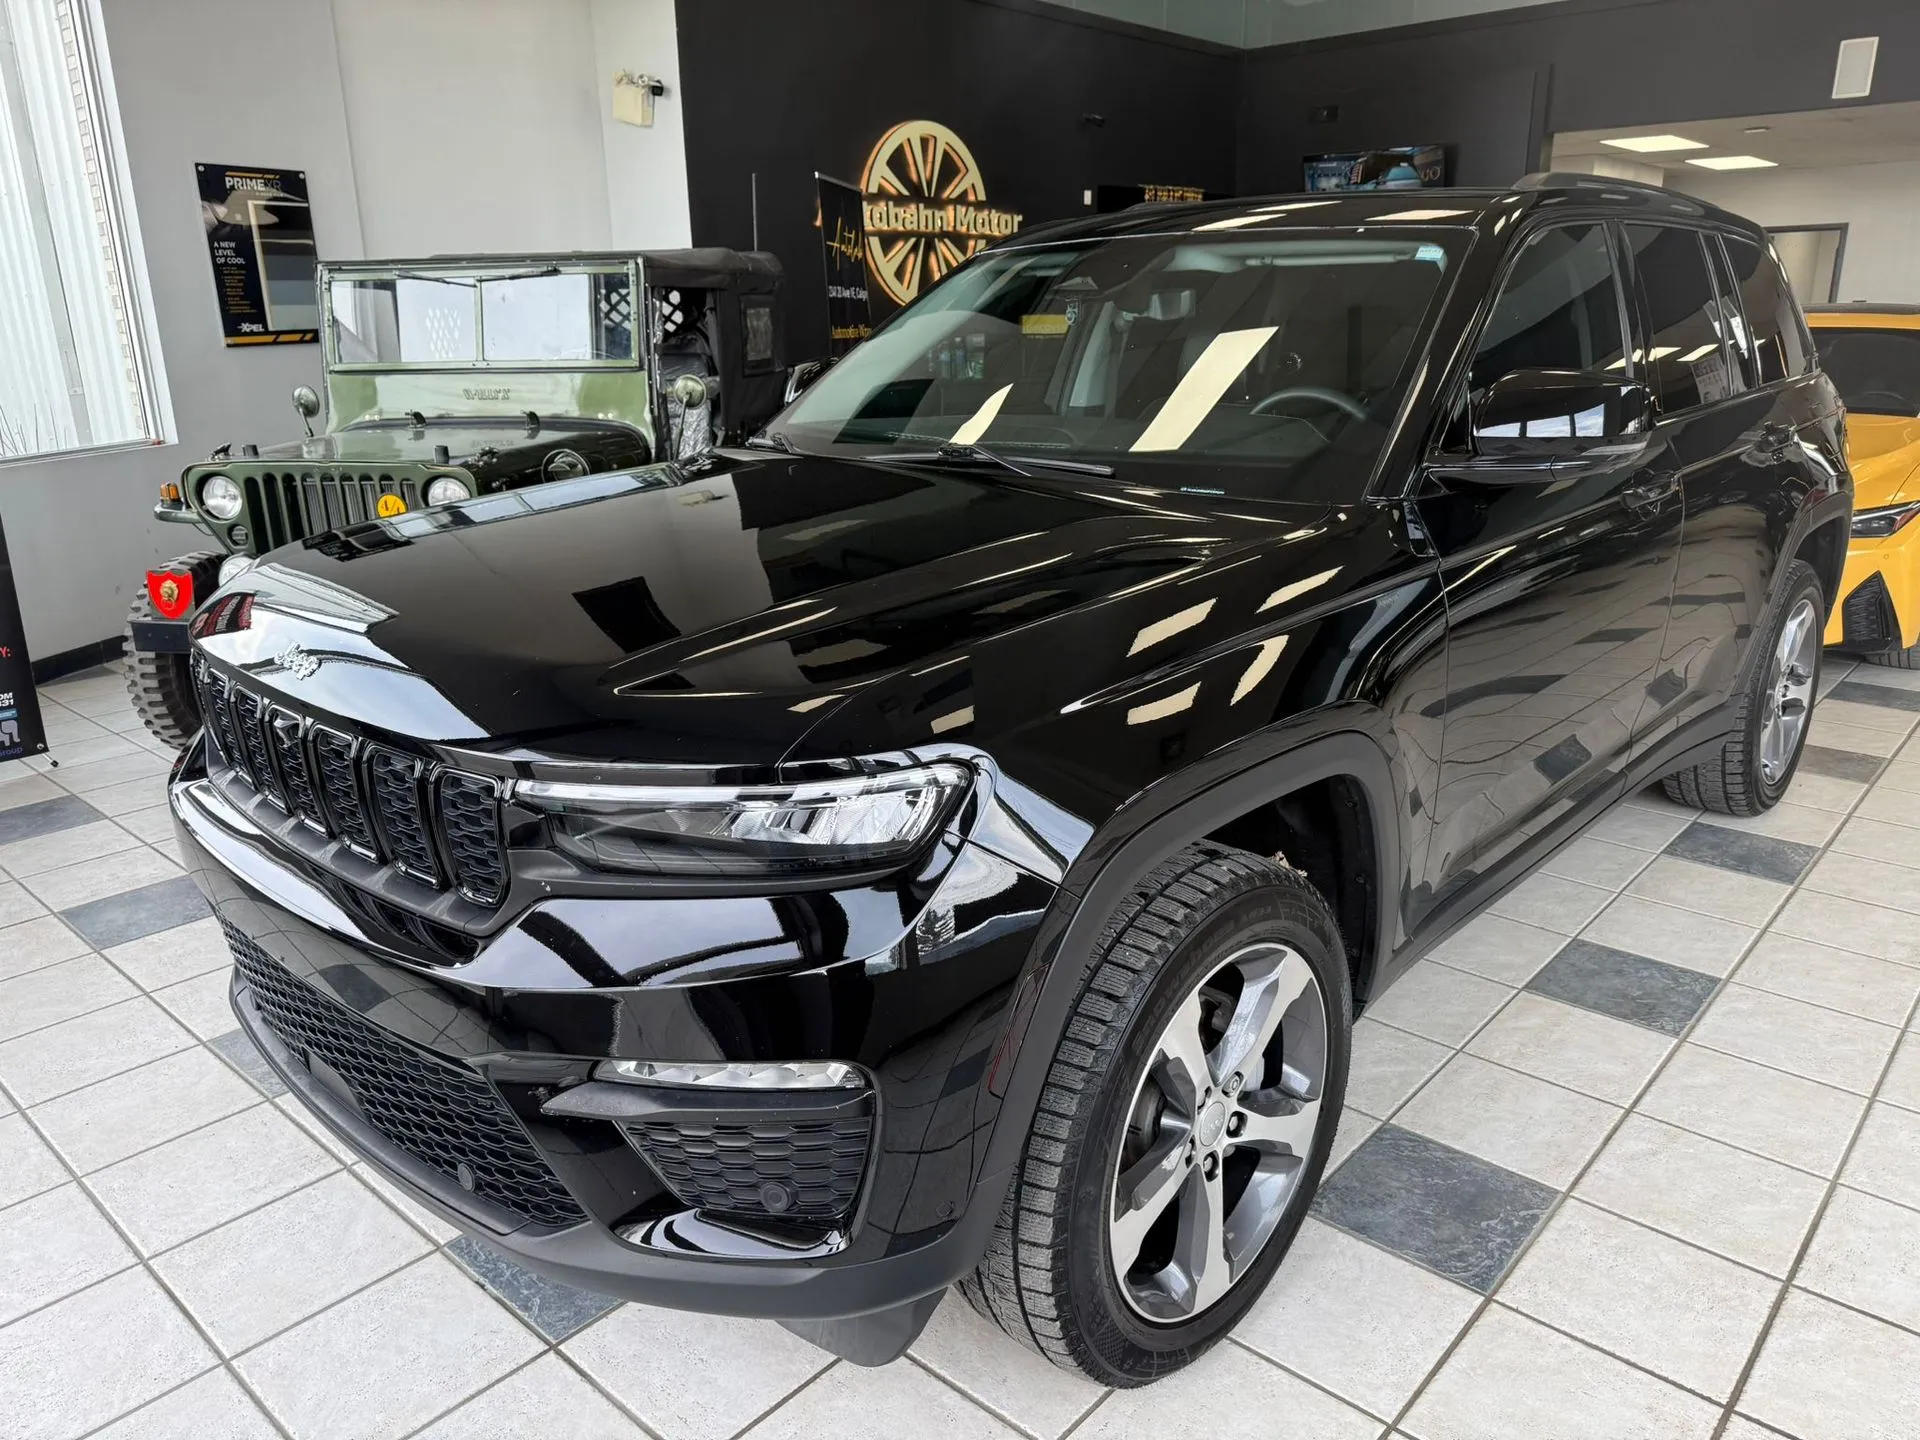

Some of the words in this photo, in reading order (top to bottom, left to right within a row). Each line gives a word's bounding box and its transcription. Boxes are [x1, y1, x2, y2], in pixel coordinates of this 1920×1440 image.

[862, 201, 948, 232] tobahn
[956, 204, 1023, 234] Motor
[240, 322, 265, 333] XPEL
